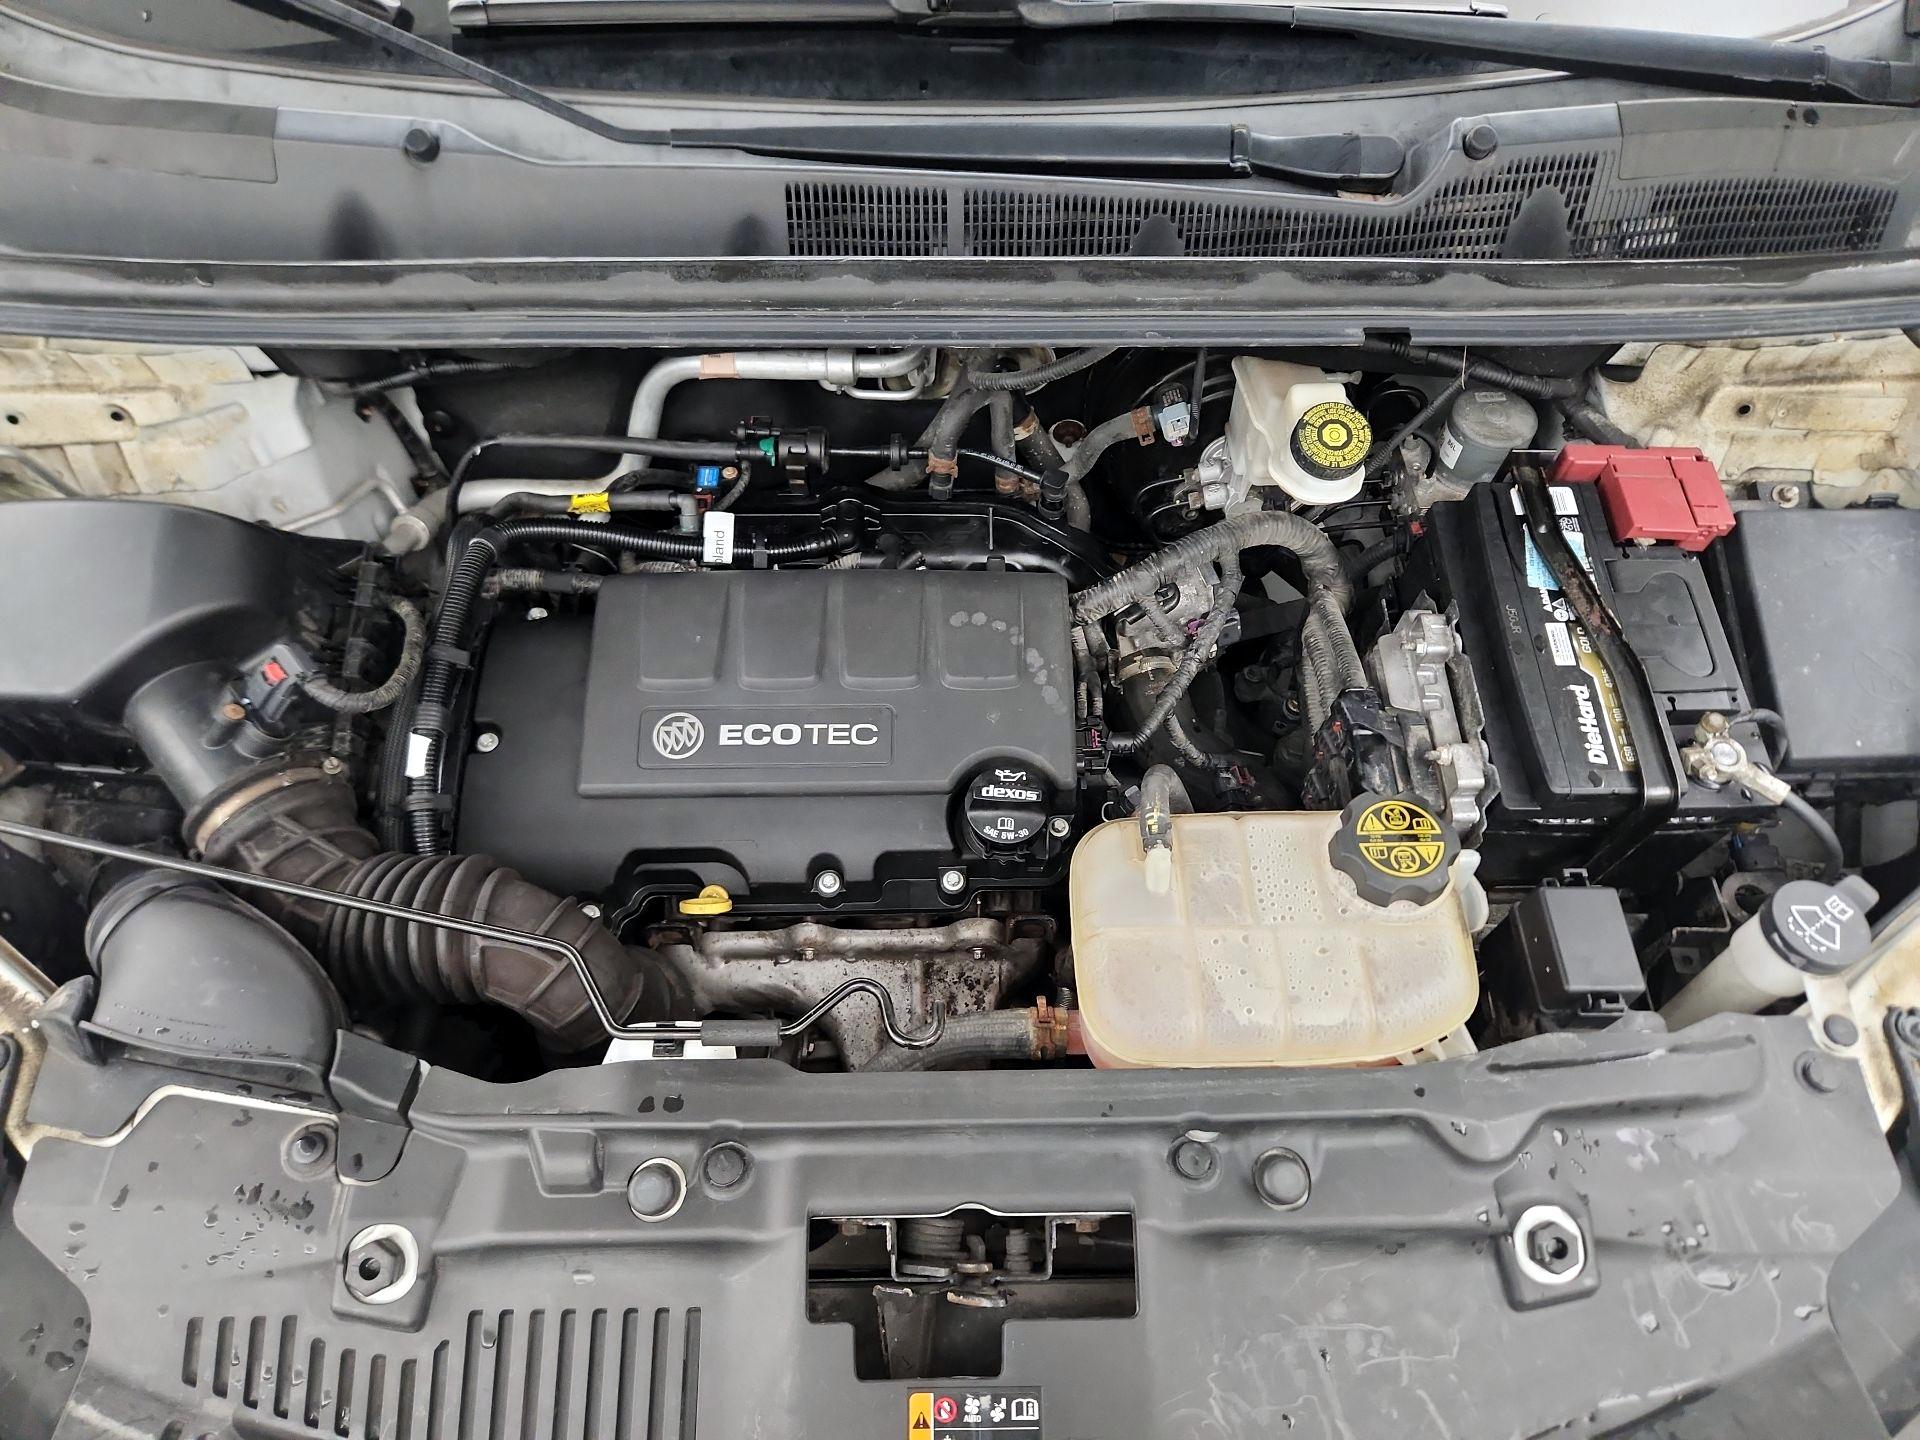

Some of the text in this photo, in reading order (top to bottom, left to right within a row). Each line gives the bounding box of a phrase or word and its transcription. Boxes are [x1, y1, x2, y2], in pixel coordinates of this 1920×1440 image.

[1560, 684, 1609, 765] DieHard
[718, 723, 879, 746] ECOTEC
[981, 784, 1040, 801] dexos
[983, 825, 1030, 840] SAE 5W-30
[962, 1414, 982, 1423] AUTO
